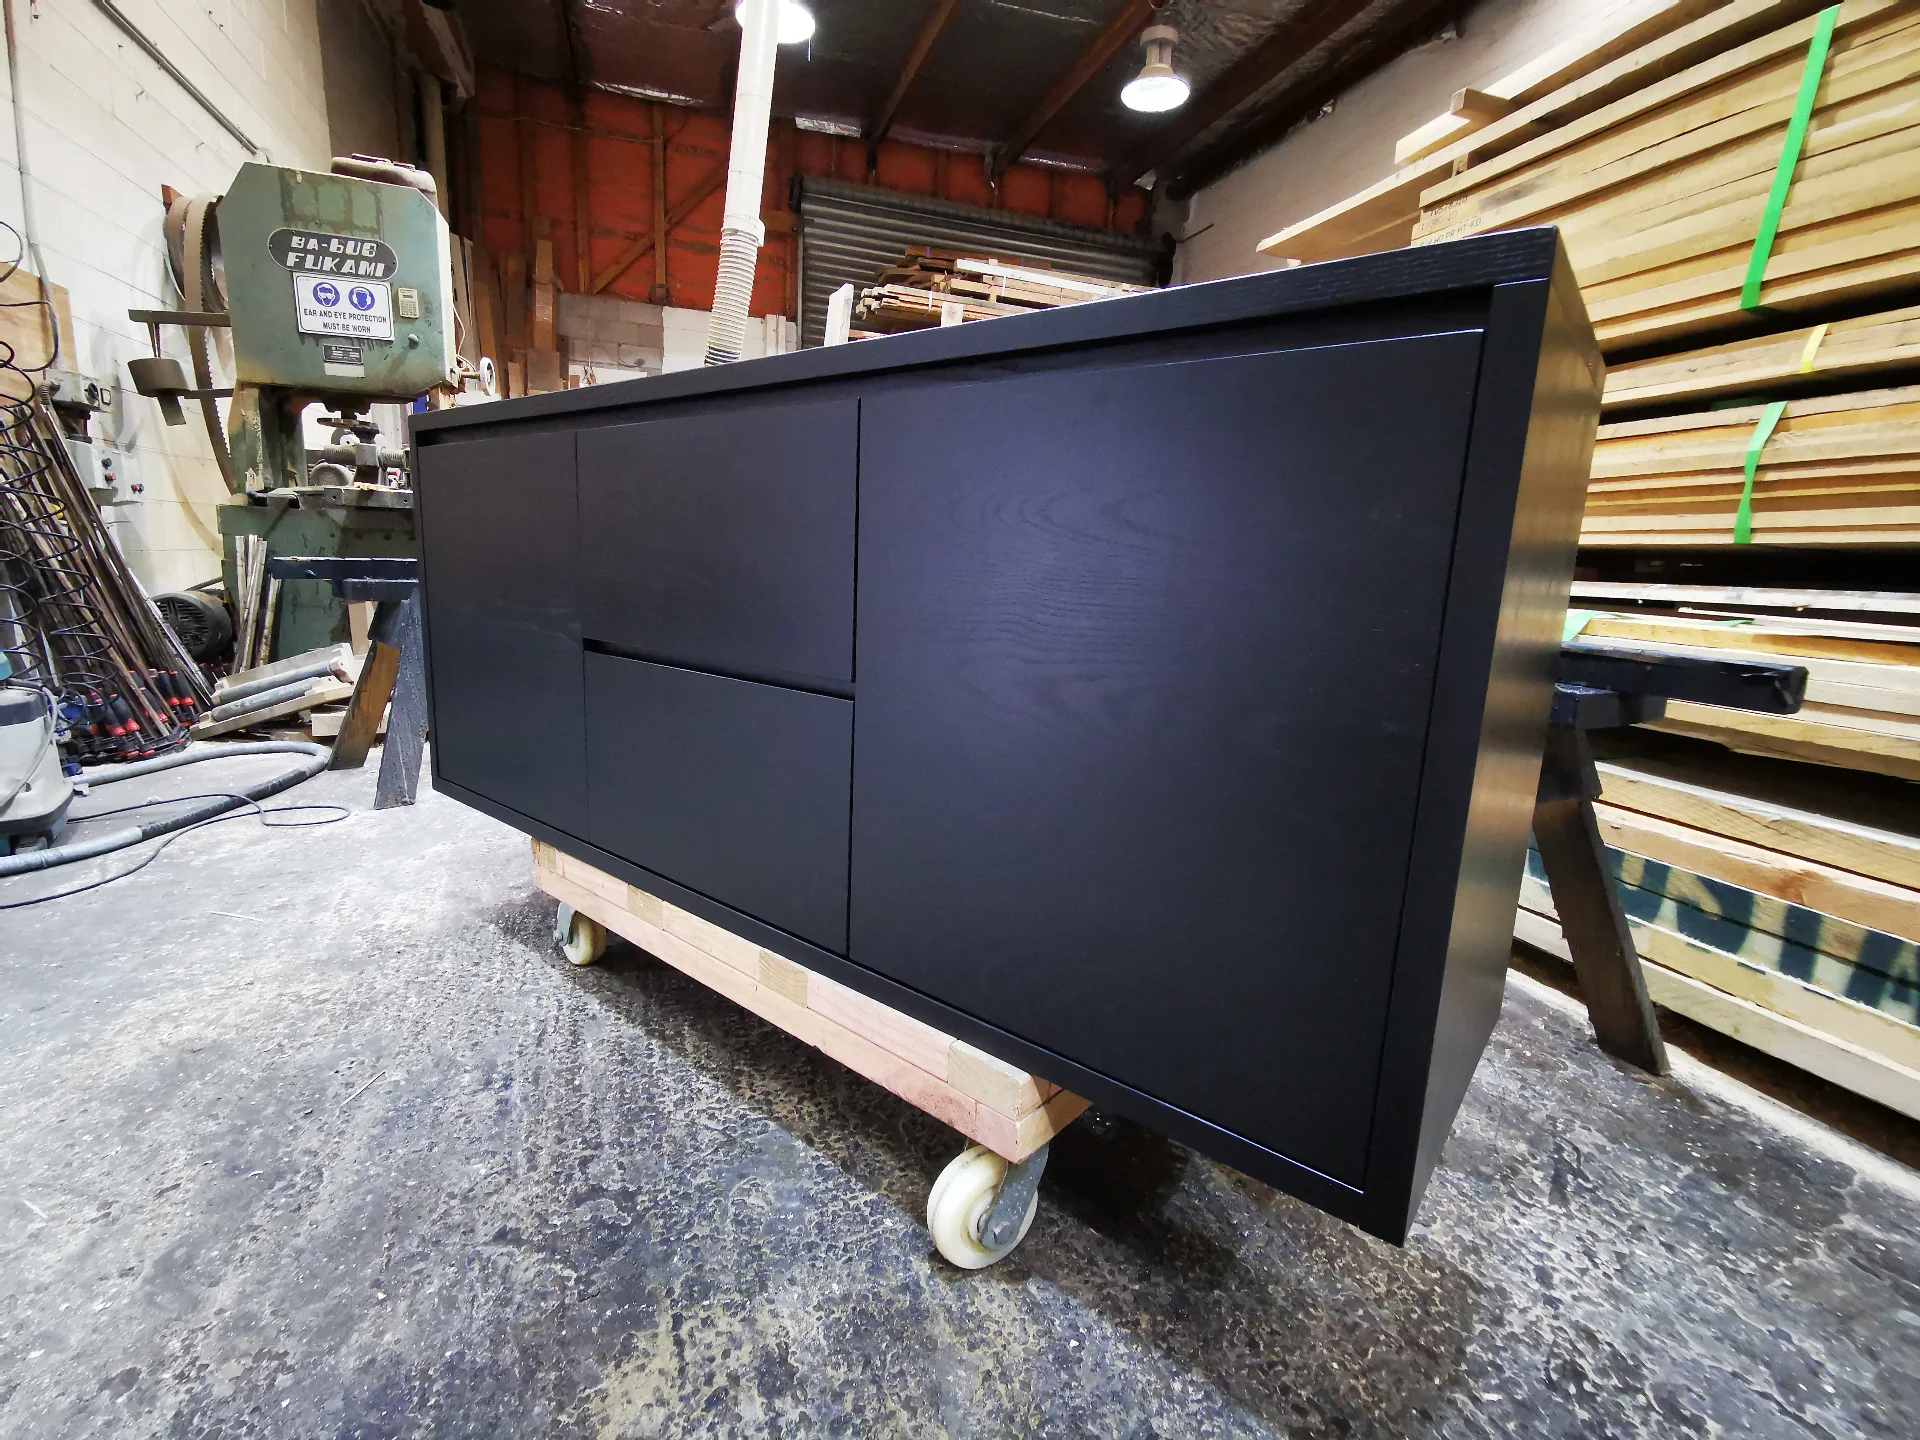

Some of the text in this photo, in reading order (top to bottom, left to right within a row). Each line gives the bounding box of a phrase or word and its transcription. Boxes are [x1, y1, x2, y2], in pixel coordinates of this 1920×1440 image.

[286, 252, 385, 277] FUKAMI
[303, 308, 387, 324] EAR AND EYE PROTECTION
[322, 321, 371, 334] MUST BE WORN
